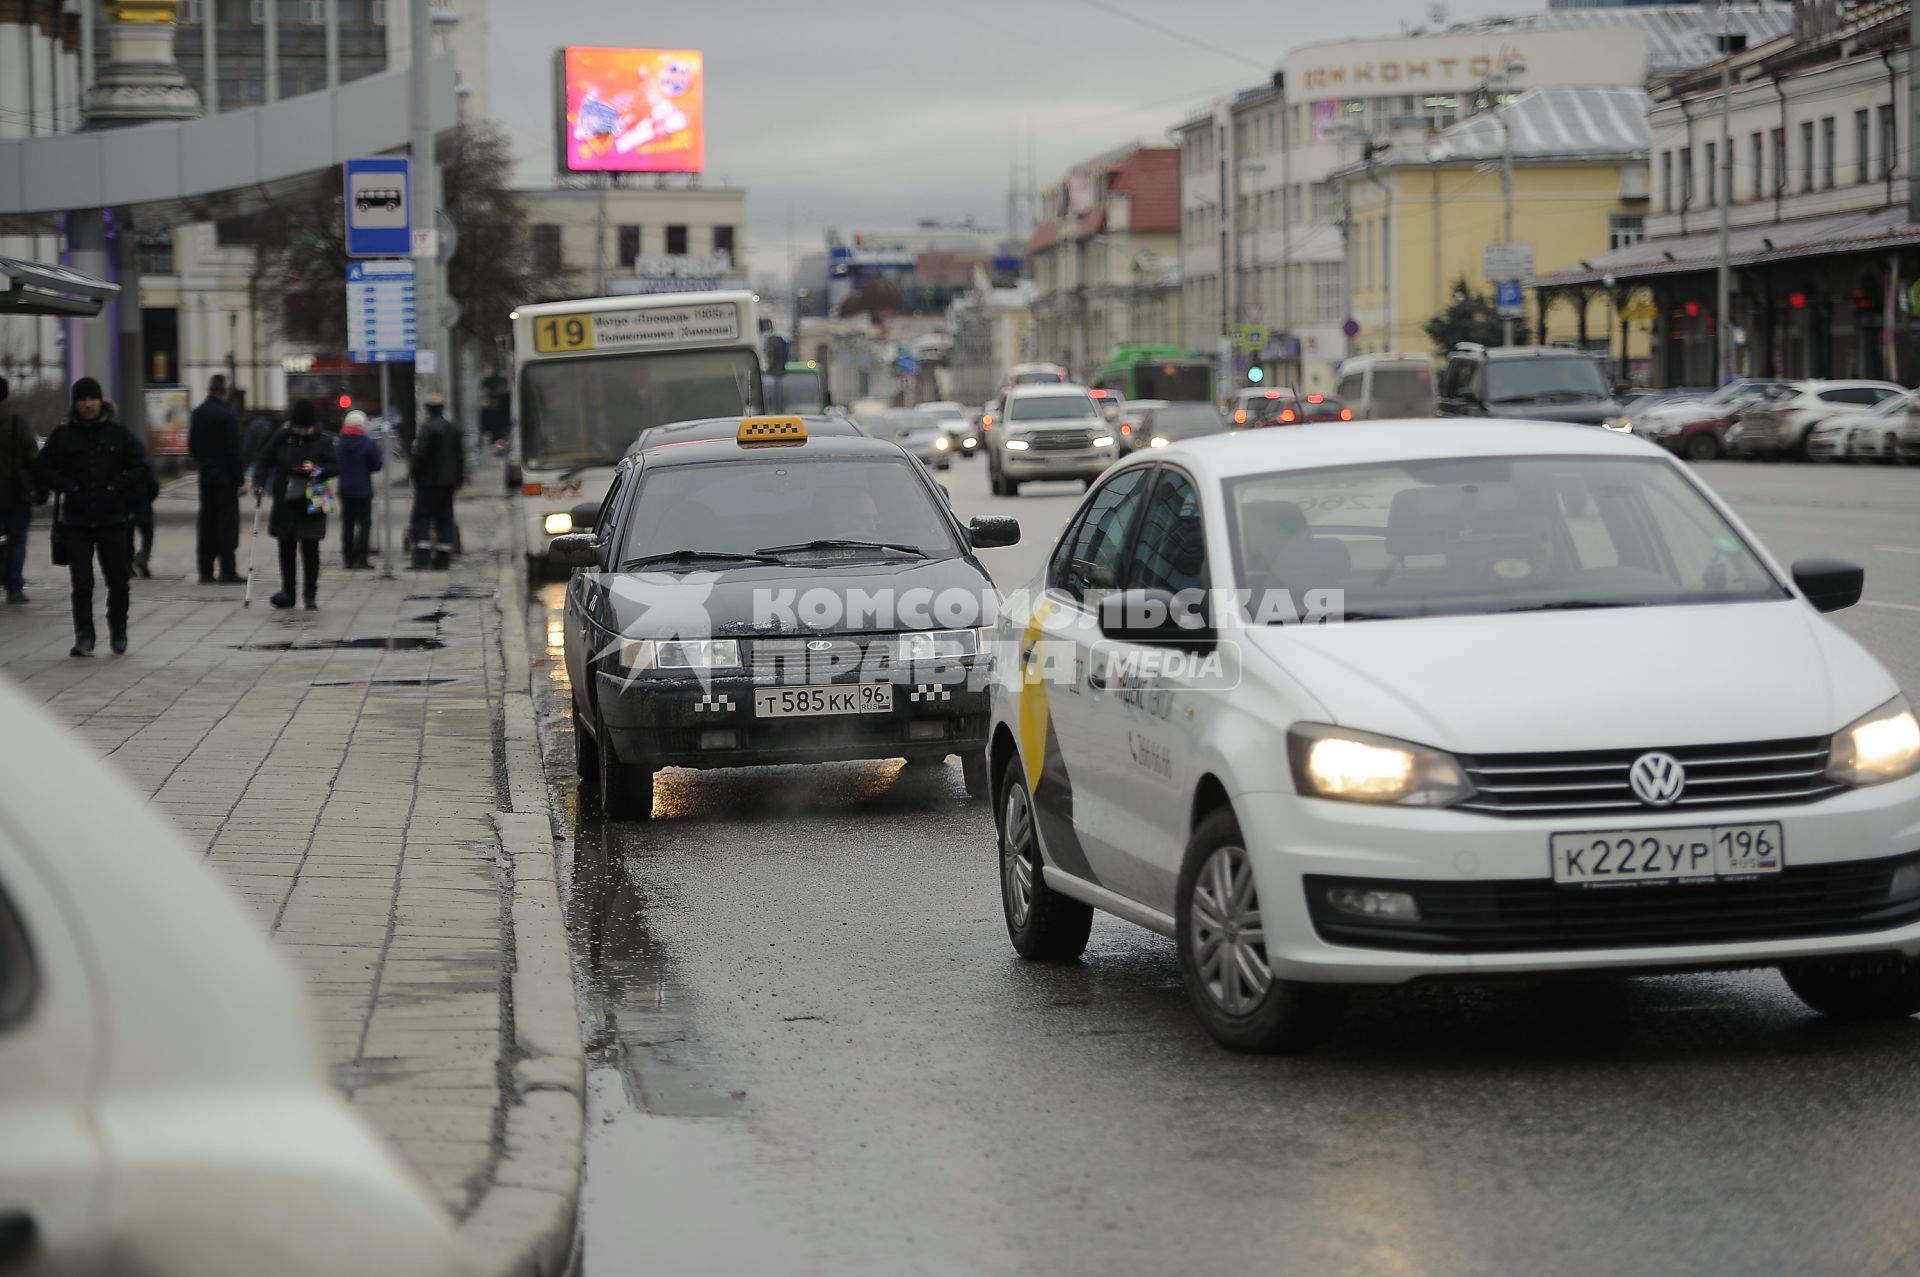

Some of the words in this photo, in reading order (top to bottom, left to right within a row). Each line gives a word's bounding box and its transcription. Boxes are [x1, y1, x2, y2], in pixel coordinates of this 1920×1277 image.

[544, 319, 585, 348] 19
[862, 687, 884, 704] 96
[861, 703, 878, 711] RUS
[1719, 829, 1772, 859] 196
[1729, 858, 1758, 870] RUS
